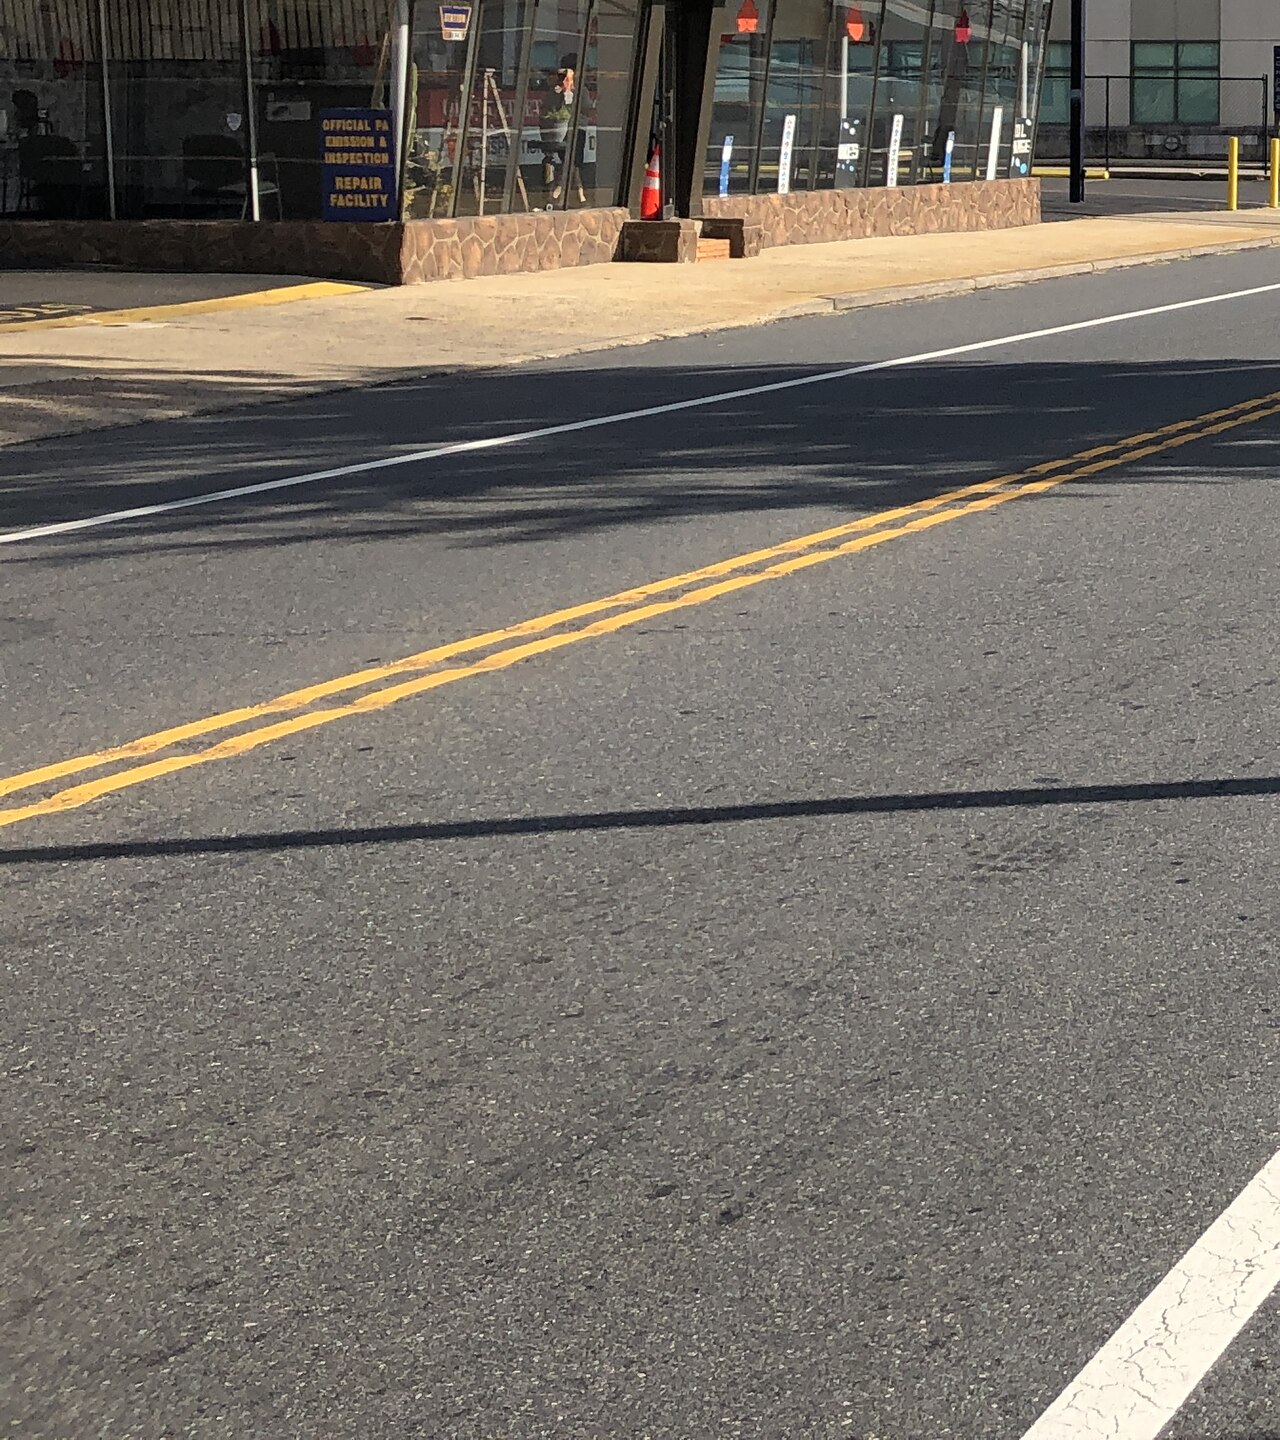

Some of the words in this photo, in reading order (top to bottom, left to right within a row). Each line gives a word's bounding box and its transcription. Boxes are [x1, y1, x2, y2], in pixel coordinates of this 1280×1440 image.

[322, 119, 371, 131] OFFICIAL
[375, 119, 389, 131] PA
[324, 152, 389, 165] INSPECTION
[335, 177, 382, 190] REPAIR
[330, 194, 389, 207] FACILITY
